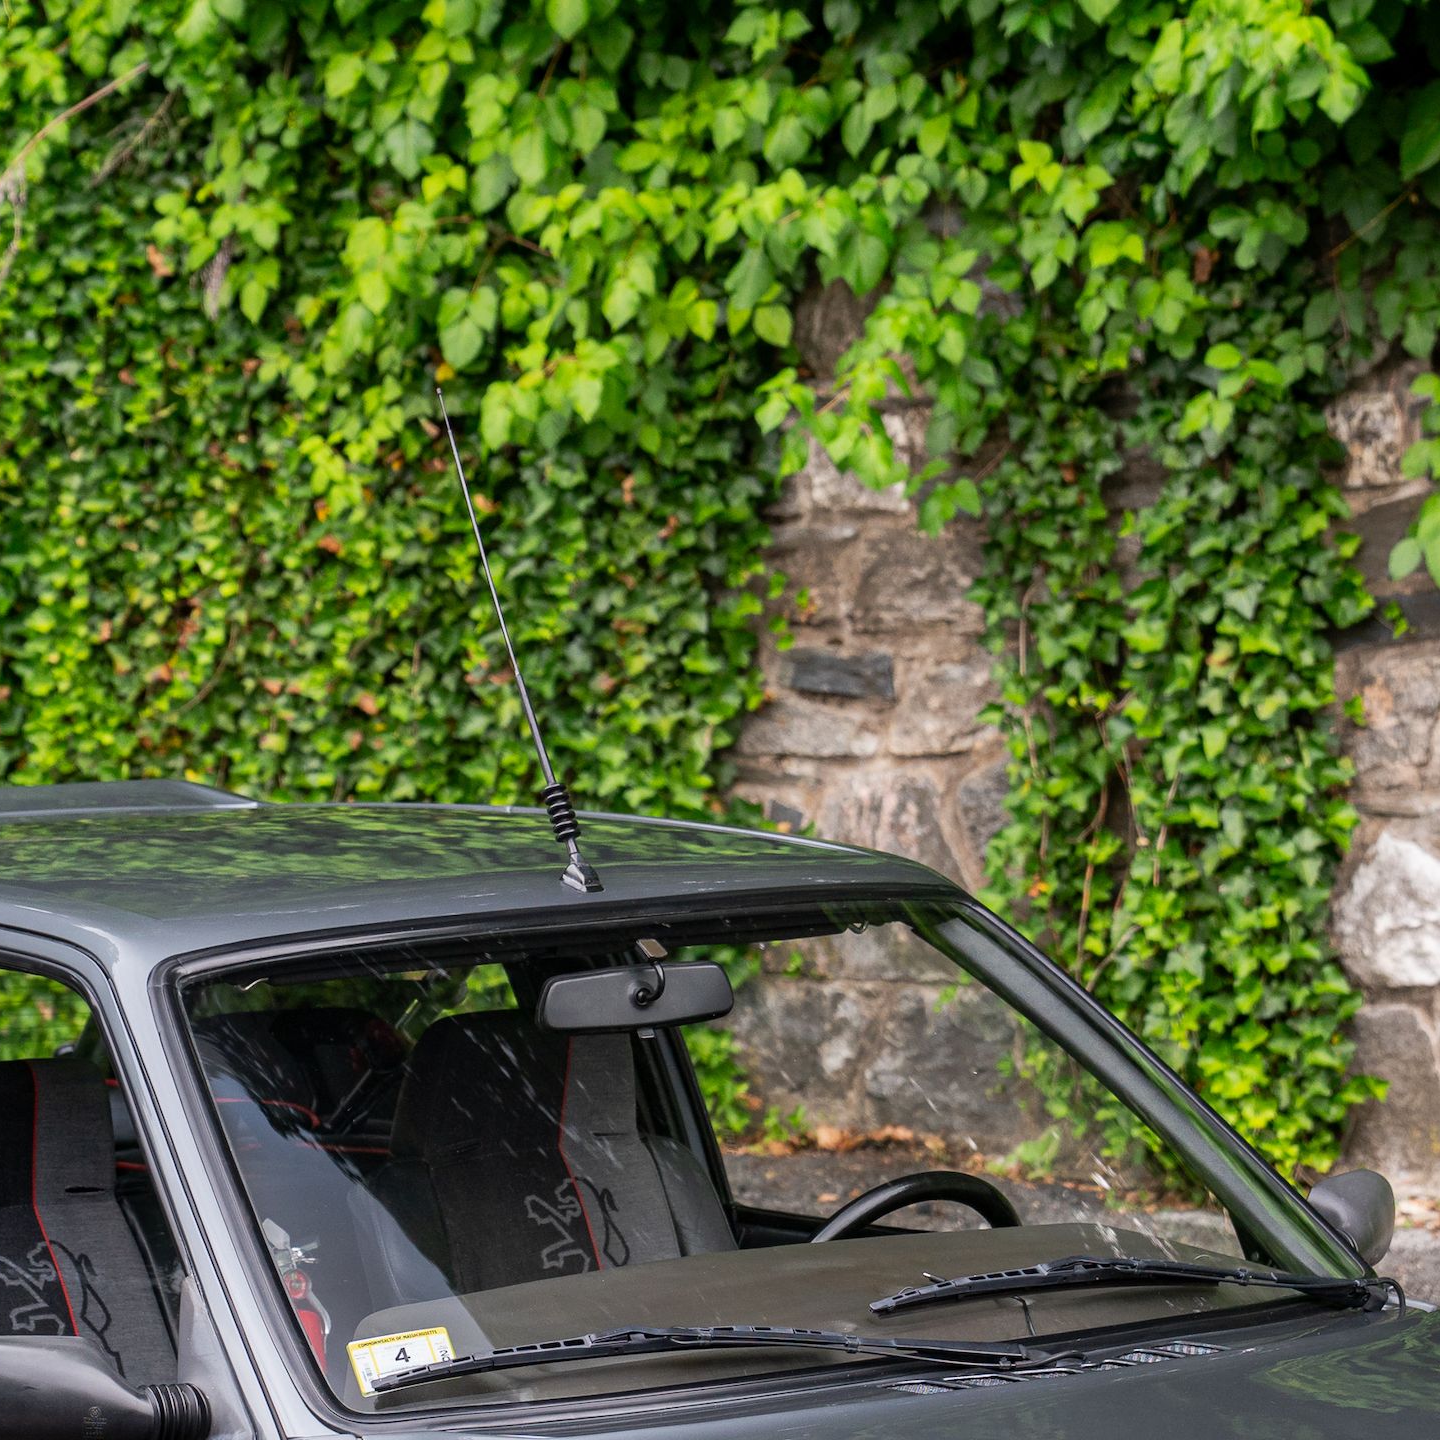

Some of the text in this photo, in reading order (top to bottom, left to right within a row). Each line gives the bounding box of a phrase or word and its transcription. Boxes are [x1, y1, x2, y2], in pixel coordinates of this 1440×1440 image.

[358, 1337, 395, 1348] COMMONWEALTH
[402, 1330, 438, 1340] MASSACHUSETTS
[394, 1347, 411, 1363] 4
